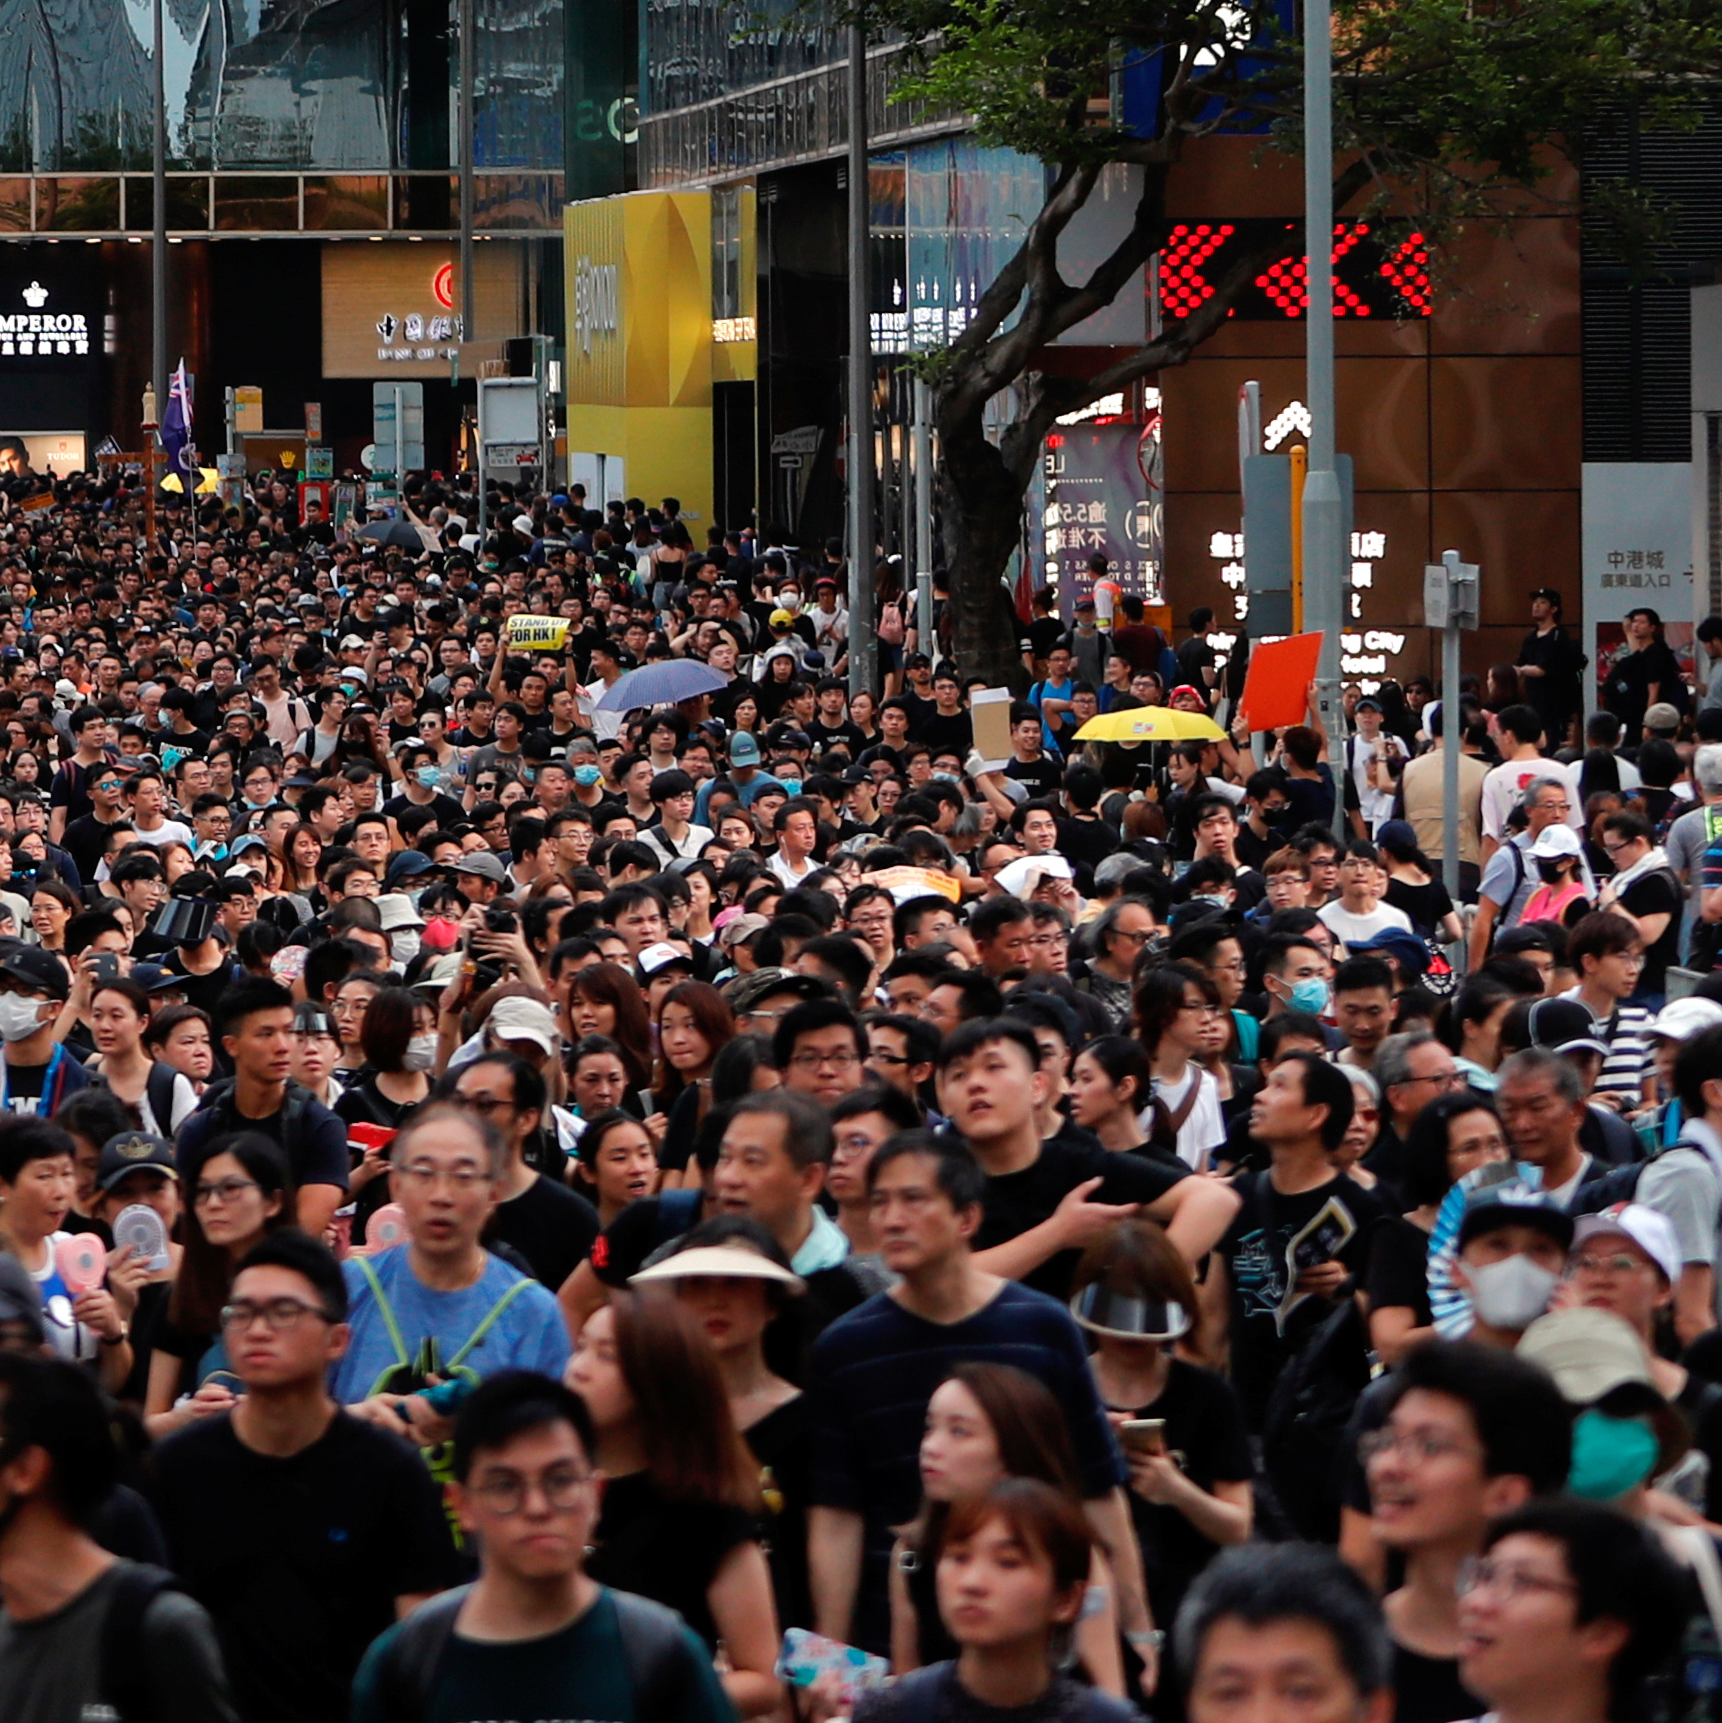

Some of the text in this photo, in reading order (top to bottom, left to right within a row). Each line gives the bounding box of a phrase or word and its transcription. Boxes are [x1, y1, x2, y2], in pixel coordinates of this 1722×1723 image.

[47, 452, 80, 461] TUDOR
[1607, 549, 1665, 570] 中港城
[510, 618, 549, 628] STAND
[510, 628, 531, 643] FOR
[1364, 630, 1405, 654] City
